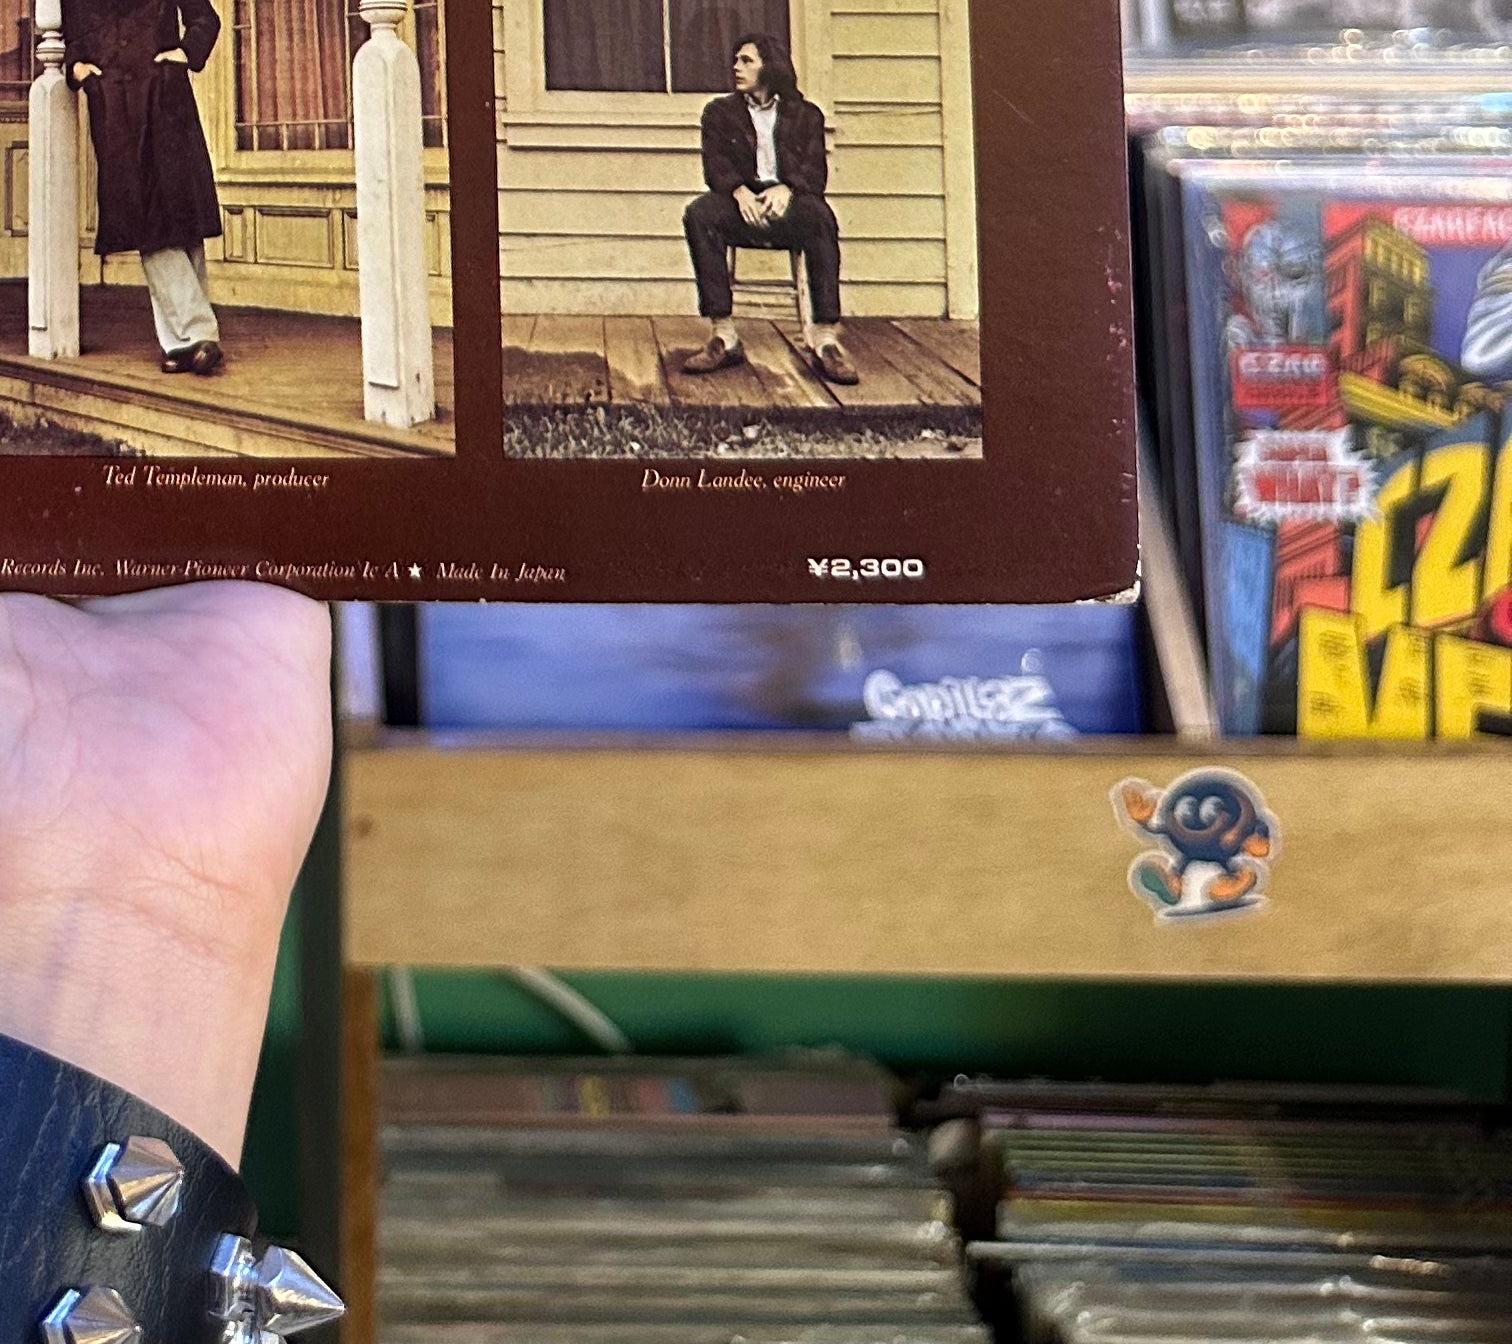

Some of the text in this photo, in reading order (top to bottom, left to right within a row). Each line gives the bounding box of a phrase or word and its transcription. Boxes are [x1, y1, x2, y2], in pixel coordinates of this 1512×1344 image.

[104, 466, 329, 490] Ted Templeman, producer
[642, 469, 845, 492] Donn Landee, engineer
[1, 559, 66, 576] Records
[74, 560, 104, 576] Inc.
[256, 561, 354, 580] Corporation
[437, 563, 479, 579] Made
[491, 563, 508, 579] In
[515, 563, 565, 582] Japan
[807, 557, 924, 580] ¥2,300
